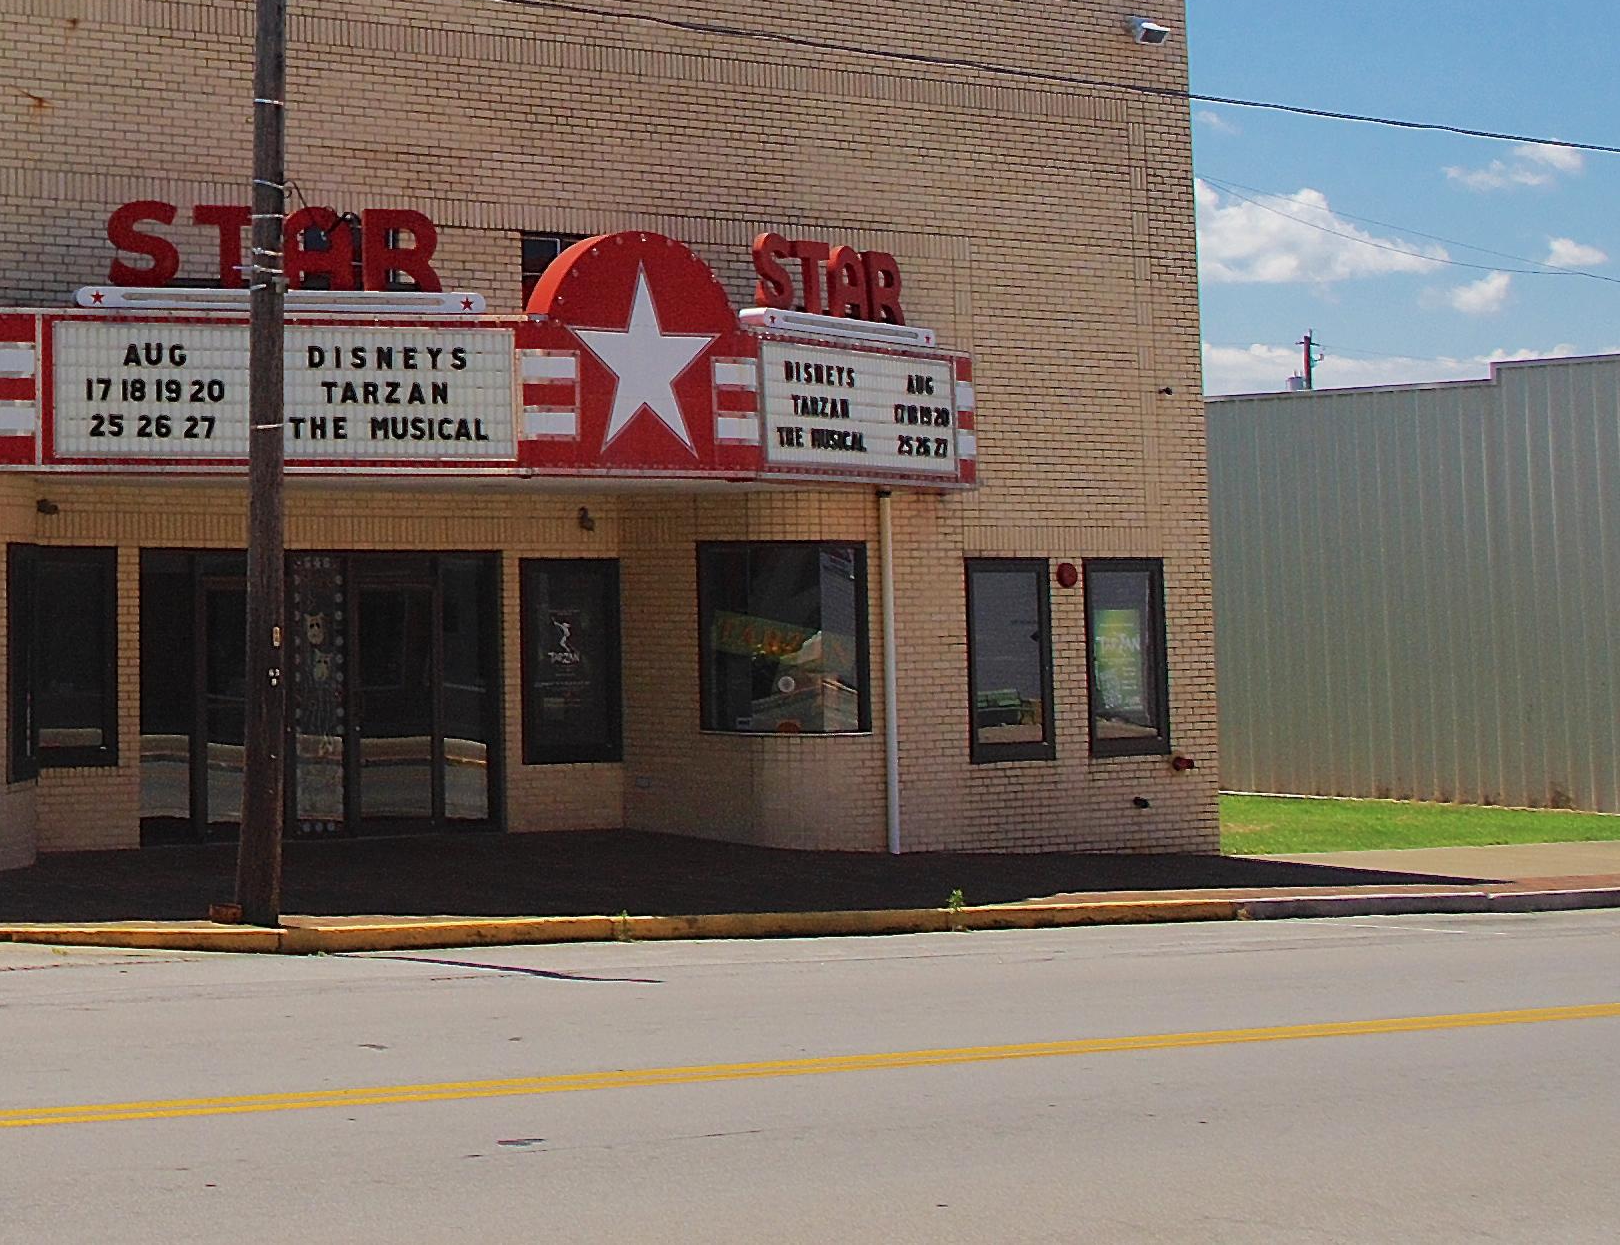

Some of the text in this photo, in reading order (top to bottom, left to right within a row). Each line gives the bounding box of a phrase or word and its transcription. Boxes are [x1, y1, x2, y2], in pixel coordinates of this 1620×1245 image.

[107, 200, 442, 292] STAR
[752, 232, 905, 326] STAR
[123, 343, 187, 367] AUG
[307, 345, 467, 370] DISNEYS
[784, 360, 855, 388] DISNEYS
[907, 374, 934, 395] AUG
[86, 378, 225, 402] 17 18 19 20
[321, 381, 448, 405] TARZAN
[791, 394, 850, 419] TARZAN
[90, 414, 215, 438] 25 26 27
[289, 417, 489, 441] THE MUSICAL
[777, 426, 805, 448] THE
